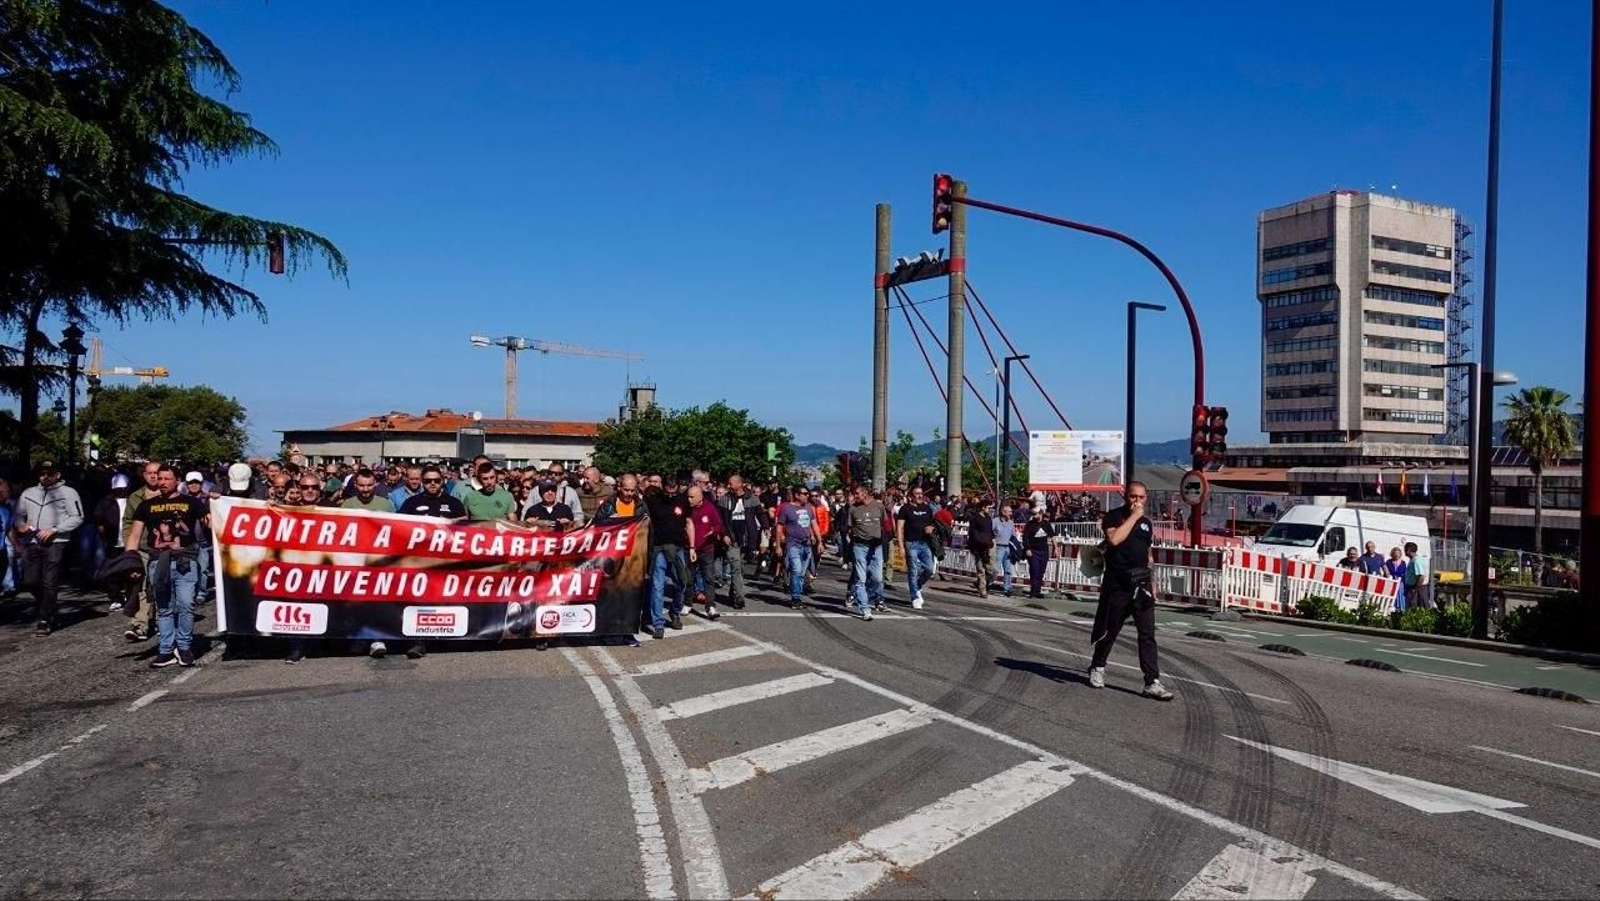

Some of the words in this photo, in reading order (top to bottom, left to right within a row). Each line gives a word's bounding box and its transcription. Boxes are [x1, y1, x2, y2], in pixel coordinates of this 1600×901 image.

[231, 513, 359, 547] CONTRA
[372, 525, 392, 548] A
[406, 527, 630, 556] PRECARIEDADE
[263, 566, 428, 597] CONVENIO
[442, 573, 535, 597] DIGNO
[274, 605, 311, 624] CIG
